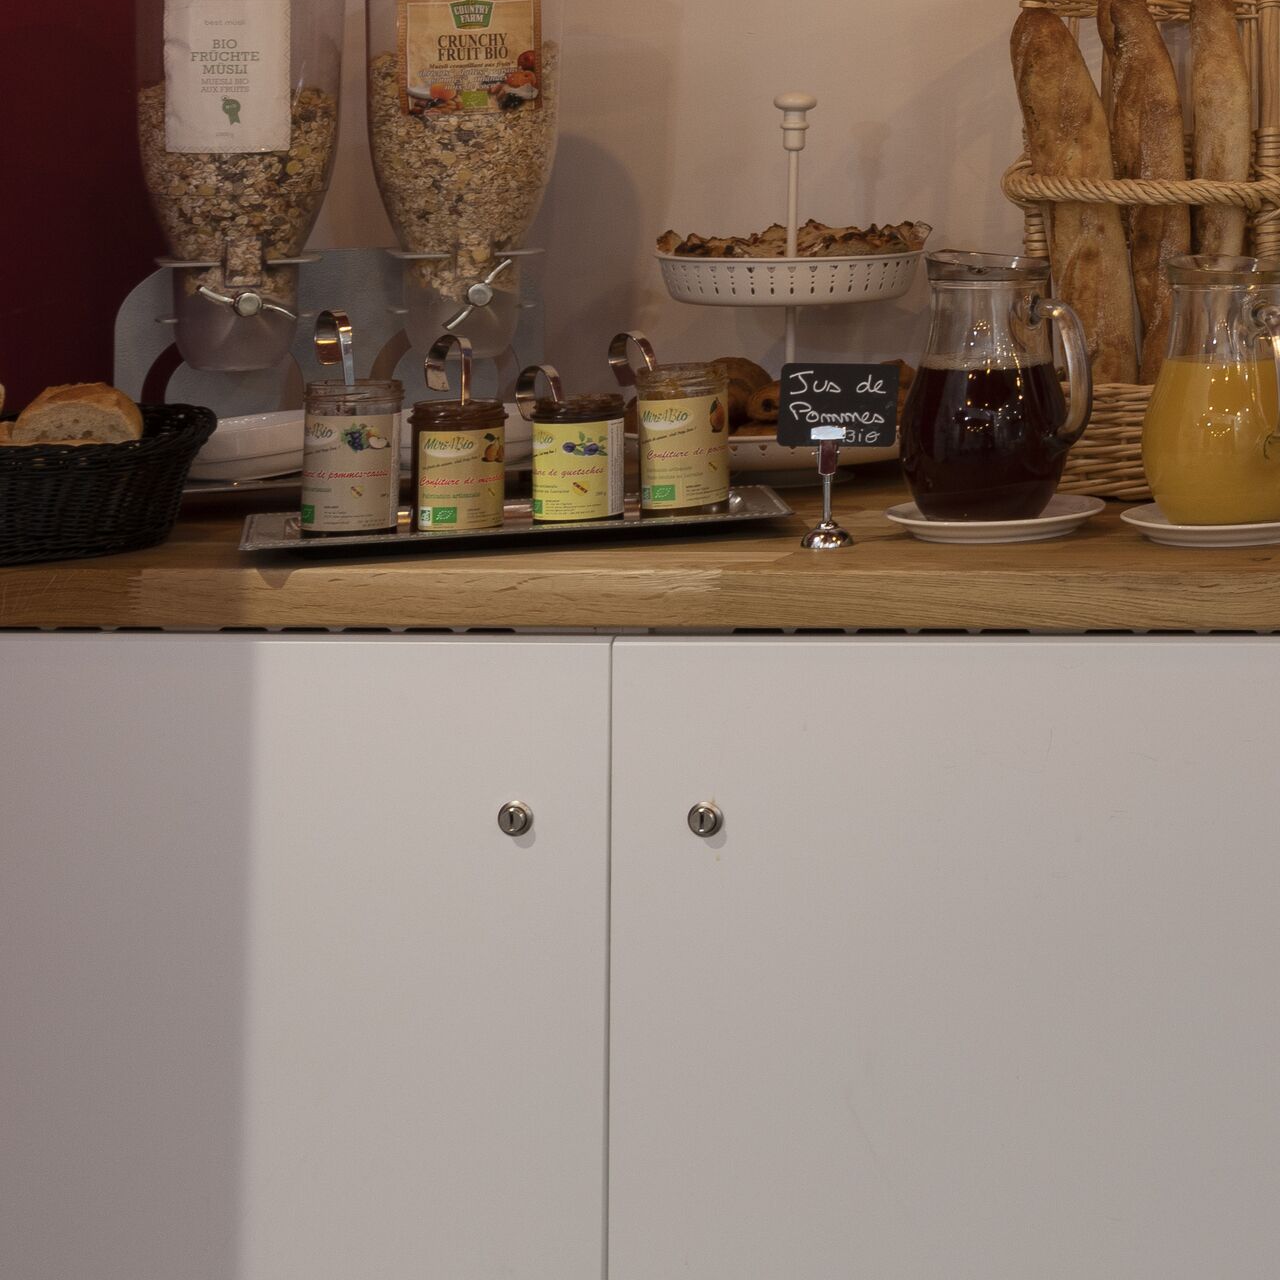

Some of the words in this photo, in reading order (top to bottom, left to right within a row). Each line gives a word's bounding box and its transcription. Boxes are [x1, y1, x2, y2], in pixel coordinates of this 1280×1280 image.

[453, 4, 490, 15] COUNTRY
[460, 14, 484, 24] FARM
[212, 38, 238, 50] BIO
[437, 33, 508, 48] CRUNCHY
[190, 50, 260, 62] FRÜCHTE
[438, 47, 481, 61] FRUIT
[485, 46, 508, 60] BIO
[202, 63, 248, 75] MÜSLI
[789, 370, 841, 395] Jus
[856, 374, 886, 394] de
[789, 401, 885, 424] Pommes
[647, 448, 689, 461] Confiture
[693, 447, 703, 456] de
[419, 476, 460, 488] Confiture
